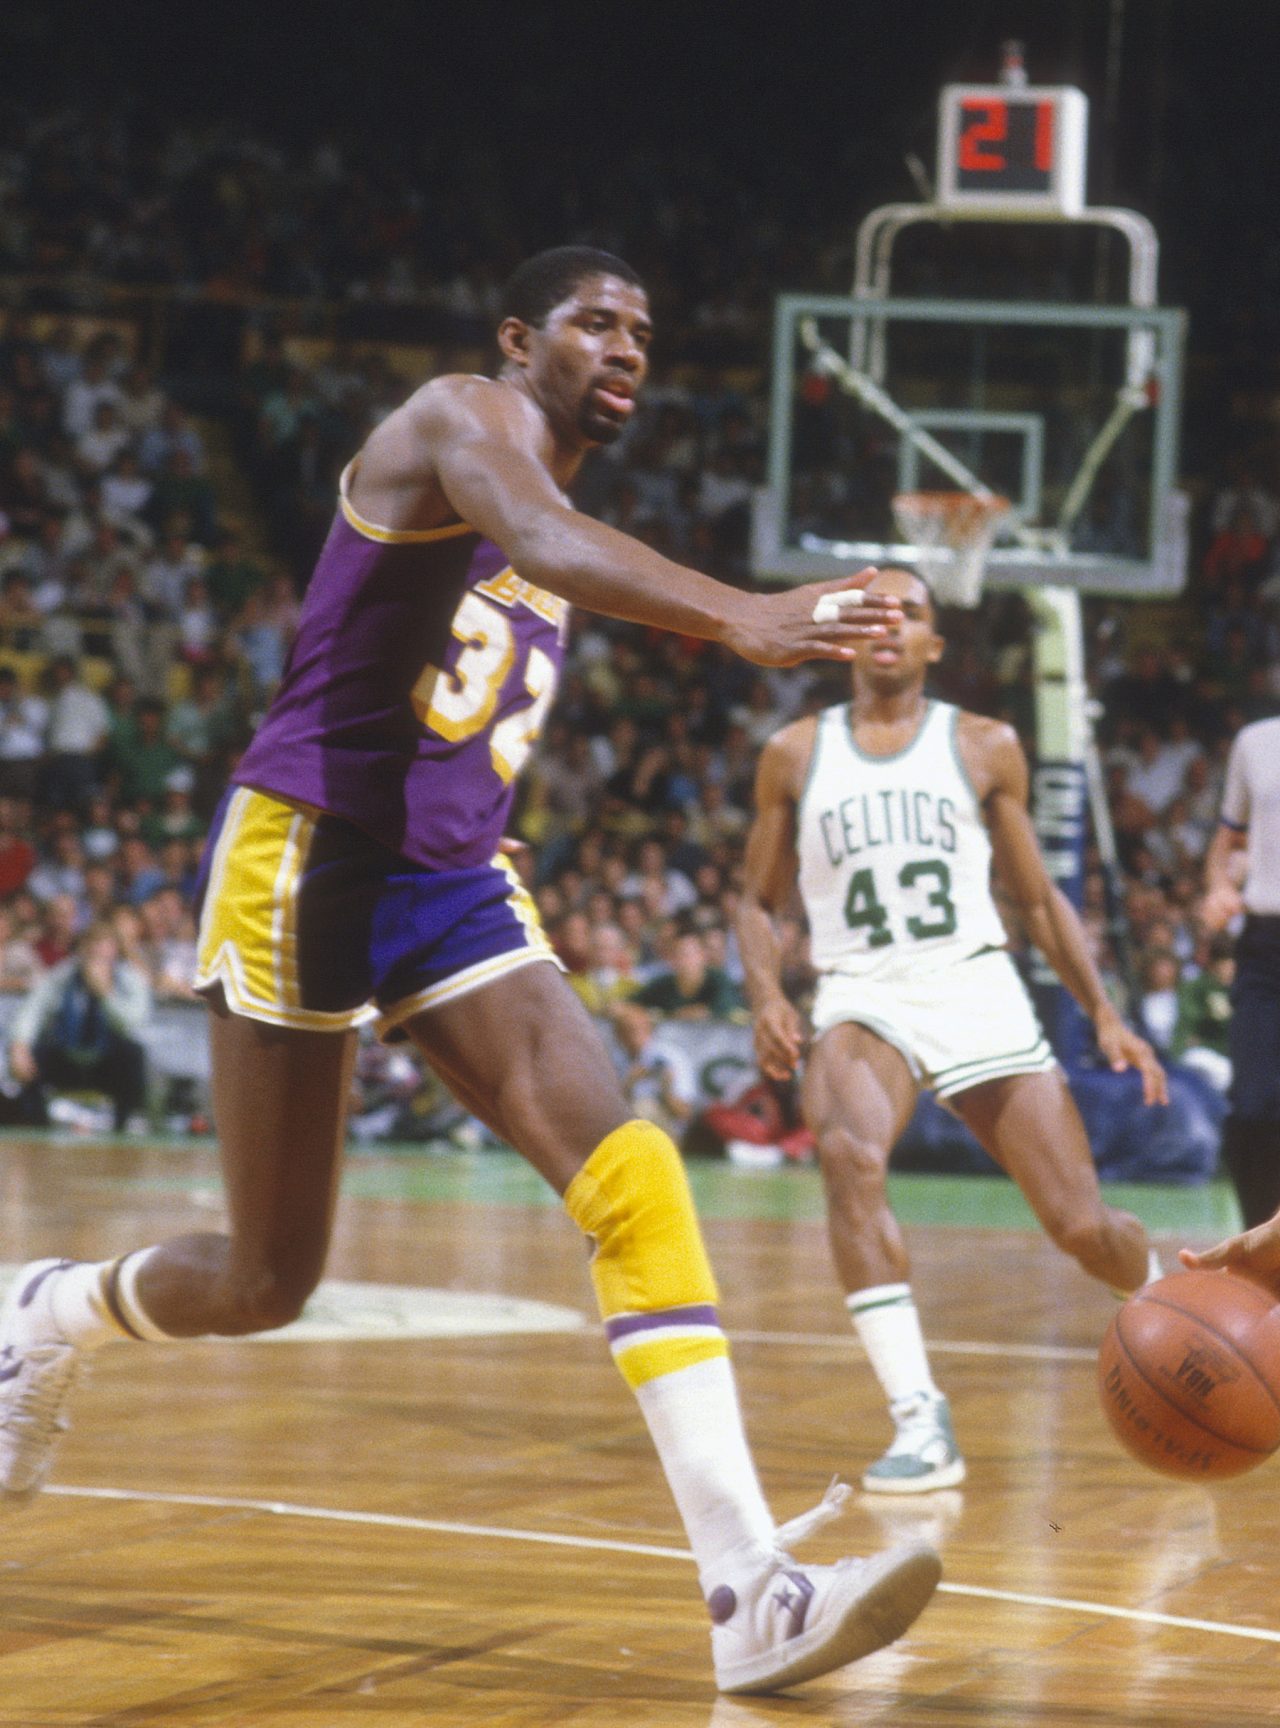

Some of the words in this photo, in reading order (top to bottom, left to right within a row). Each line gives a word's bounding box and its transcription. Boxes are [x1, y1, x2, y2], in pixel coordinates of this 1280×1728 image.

[957, 97, 1055, 172] 21
[410, 590, 557, 787] 32
[819, 789, 959, 868] CELTICS
[843, 858, 959, 947] 43
